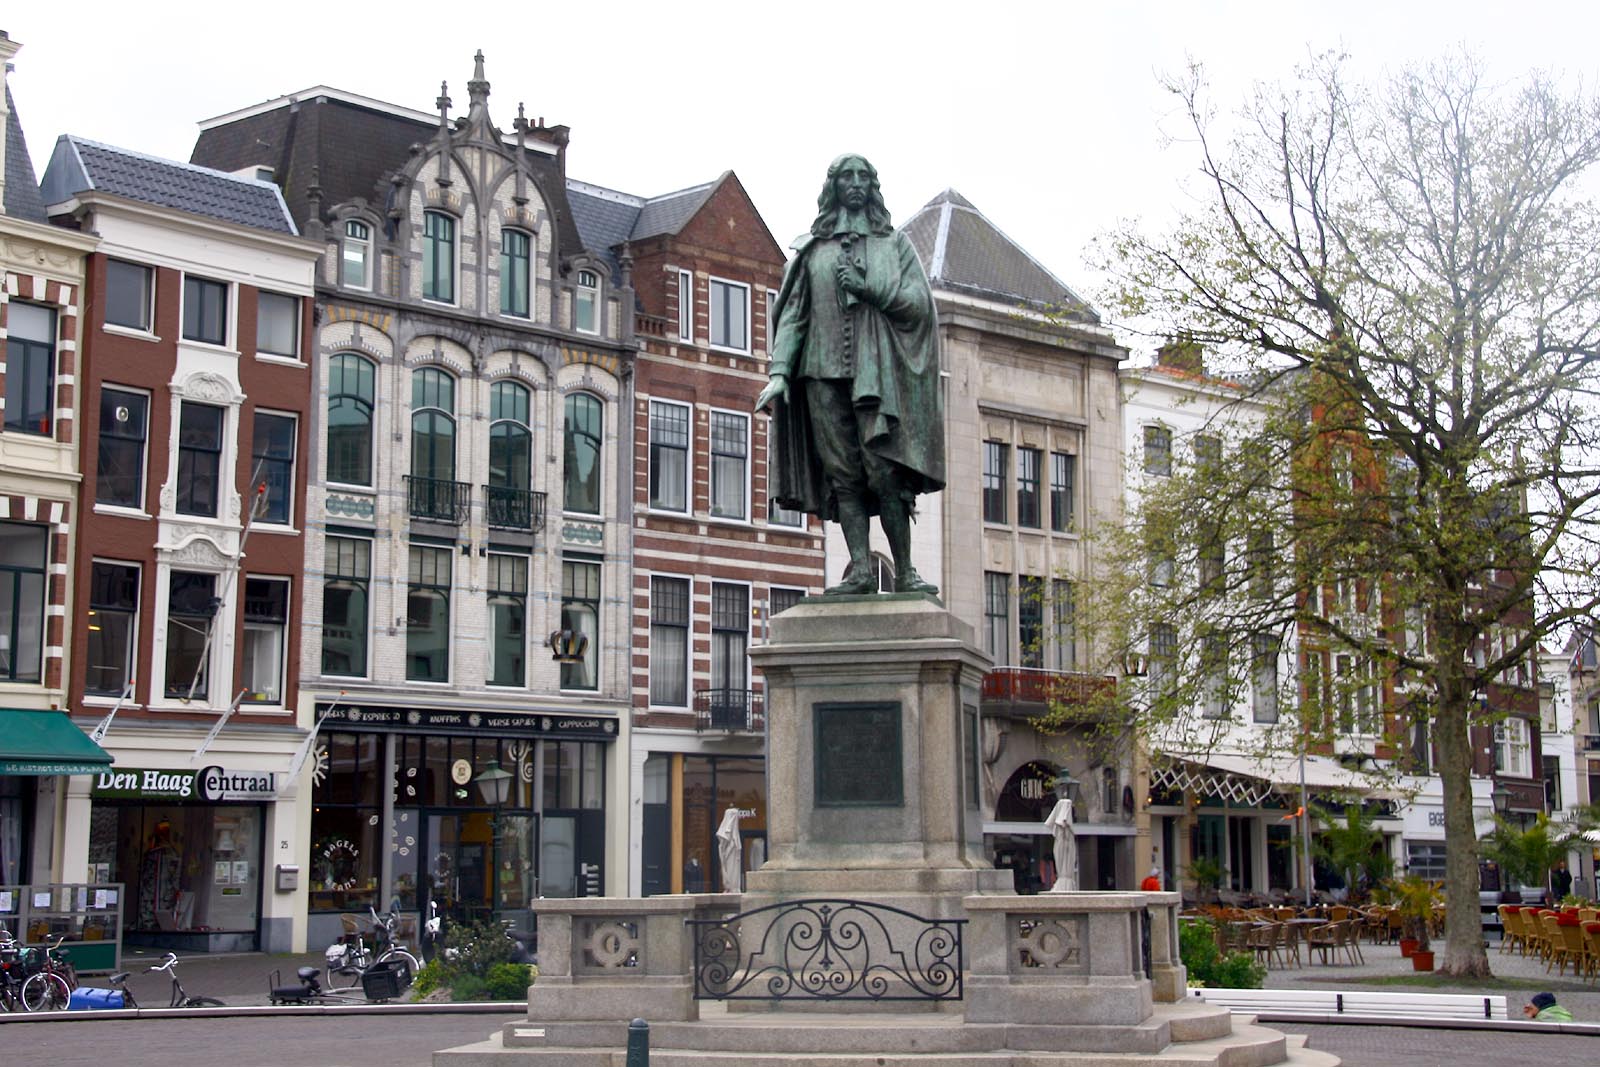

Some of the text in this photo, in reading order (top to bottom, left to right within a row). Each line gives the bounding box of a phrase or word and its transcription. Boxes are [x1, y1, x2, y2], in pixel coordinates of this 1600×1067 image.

[558, 720, 600, 729] CAPPUCCINO
[97, 765, 275, 801] Den Haag Centraal
[280, 841, 289, 849] 25
[324, 840, 359, 858] BAGELS
